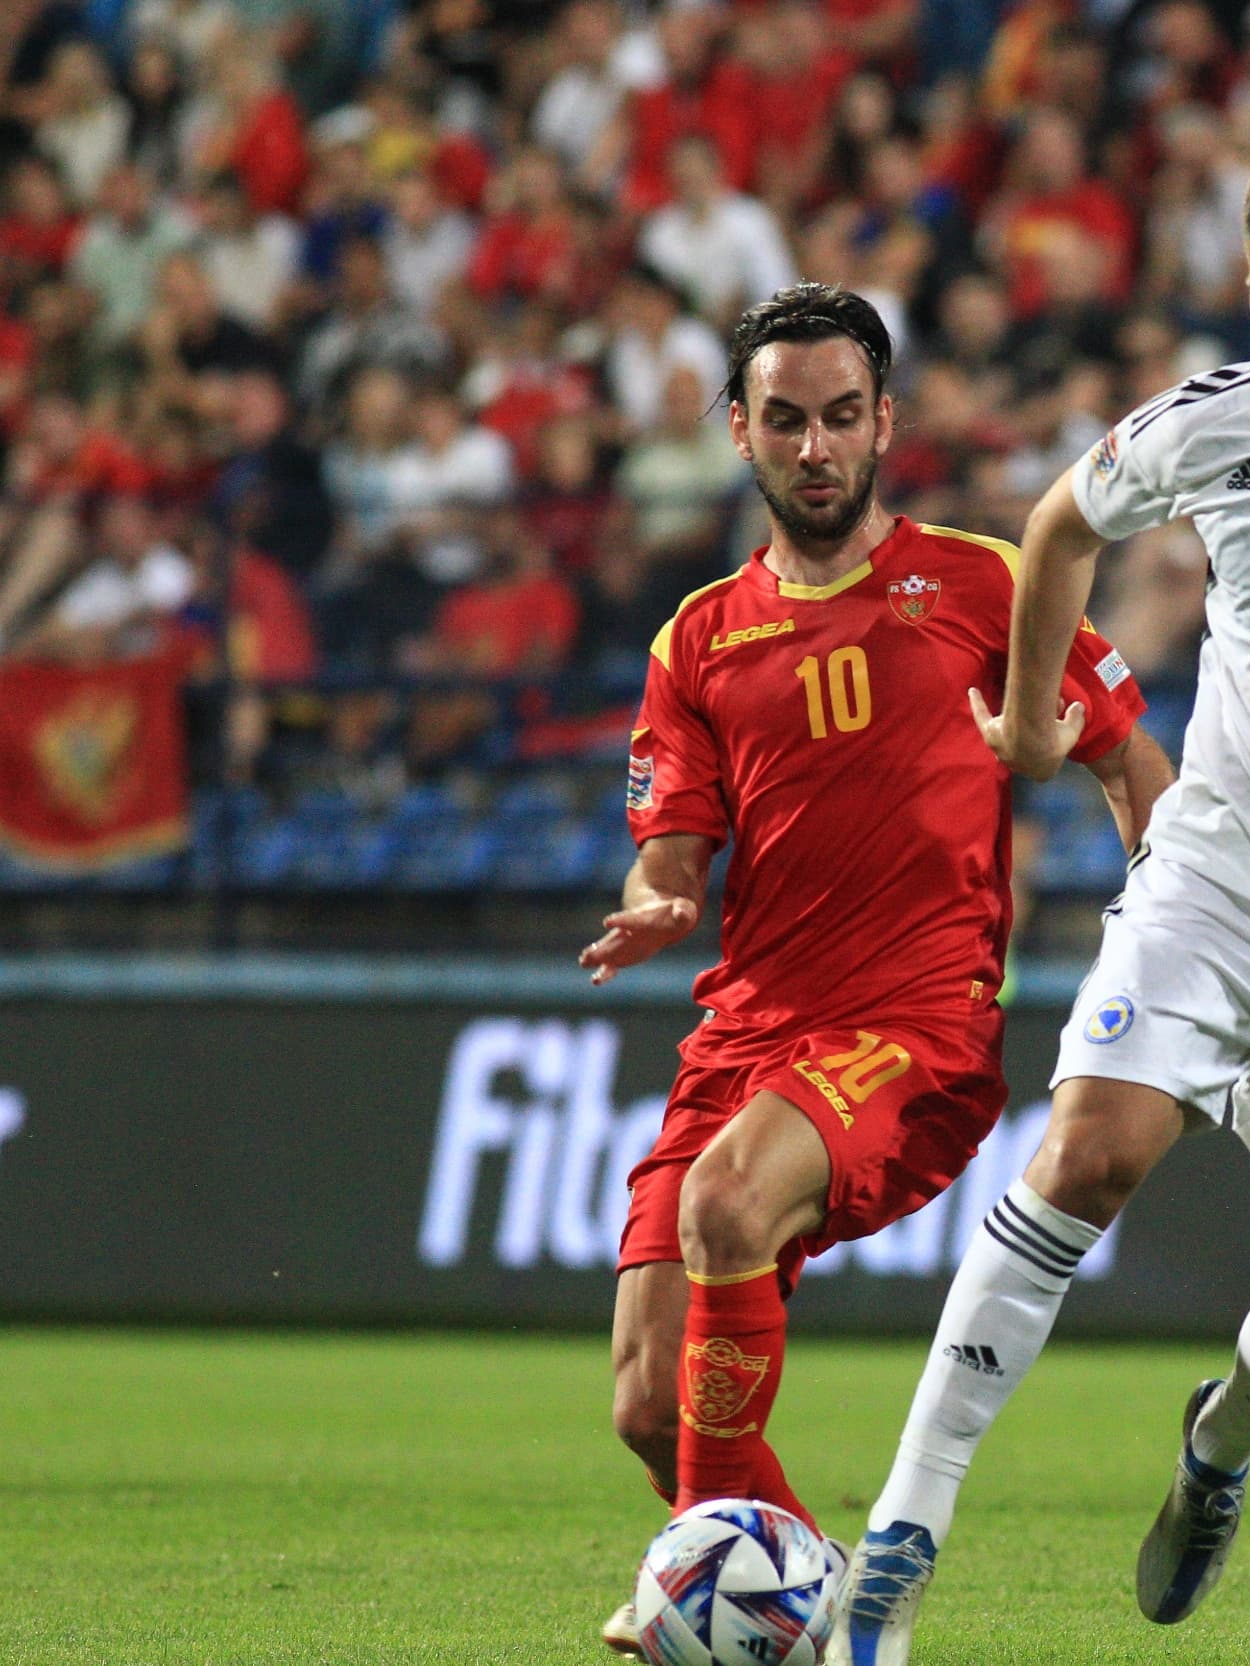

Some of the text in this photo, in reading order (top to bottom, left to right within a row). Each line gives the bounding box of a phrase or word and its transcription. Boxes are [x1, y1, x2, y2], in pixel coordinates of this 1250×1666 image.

[709, 618, 796, 651] LEGEA
[794, 645, 872, 739] 10
[792, 1060, 855, 1131] LEGEA
[819, 1030, 911, 1104] 10
